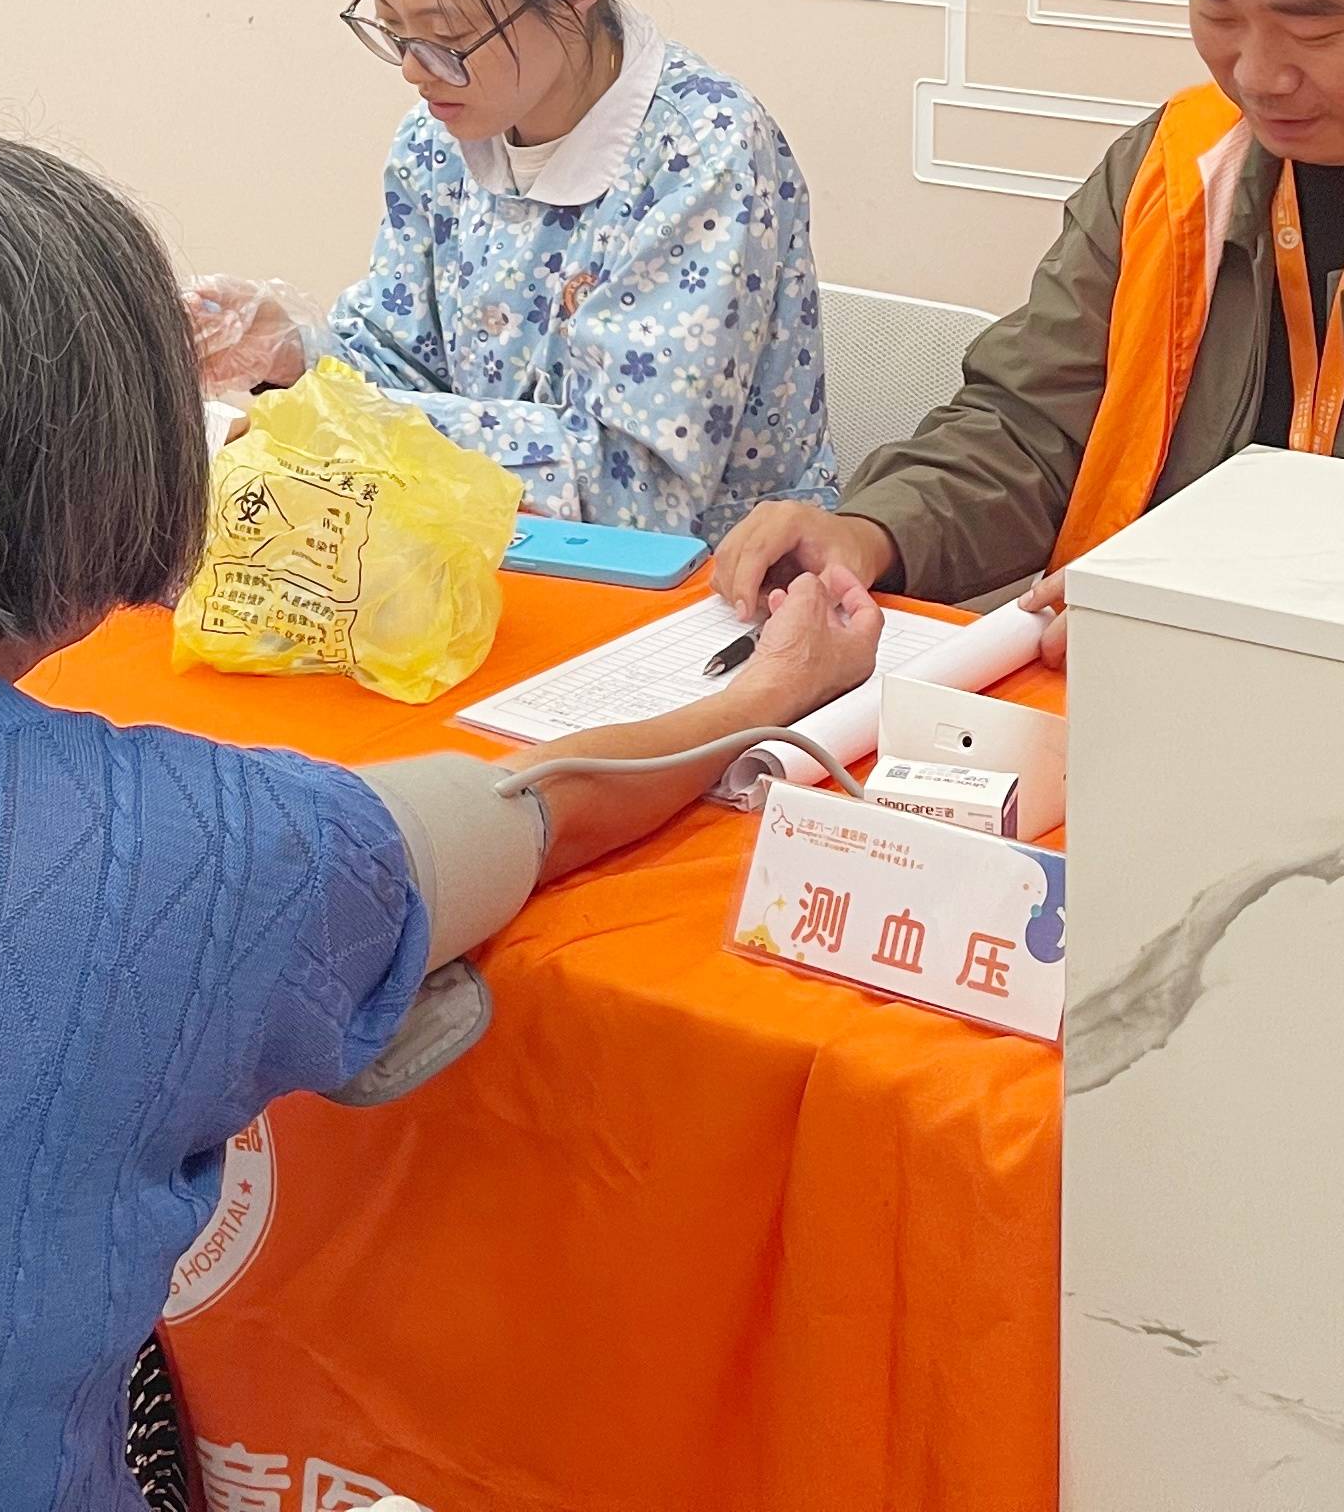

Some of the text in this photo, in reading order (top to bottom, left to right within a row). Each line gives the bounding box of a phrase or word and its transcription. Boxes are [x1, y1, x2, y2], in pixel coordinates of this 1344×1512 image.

[791, 881, 1017, 999] 测血压
[178, 1198, 252, 1288] HOSPITAL
